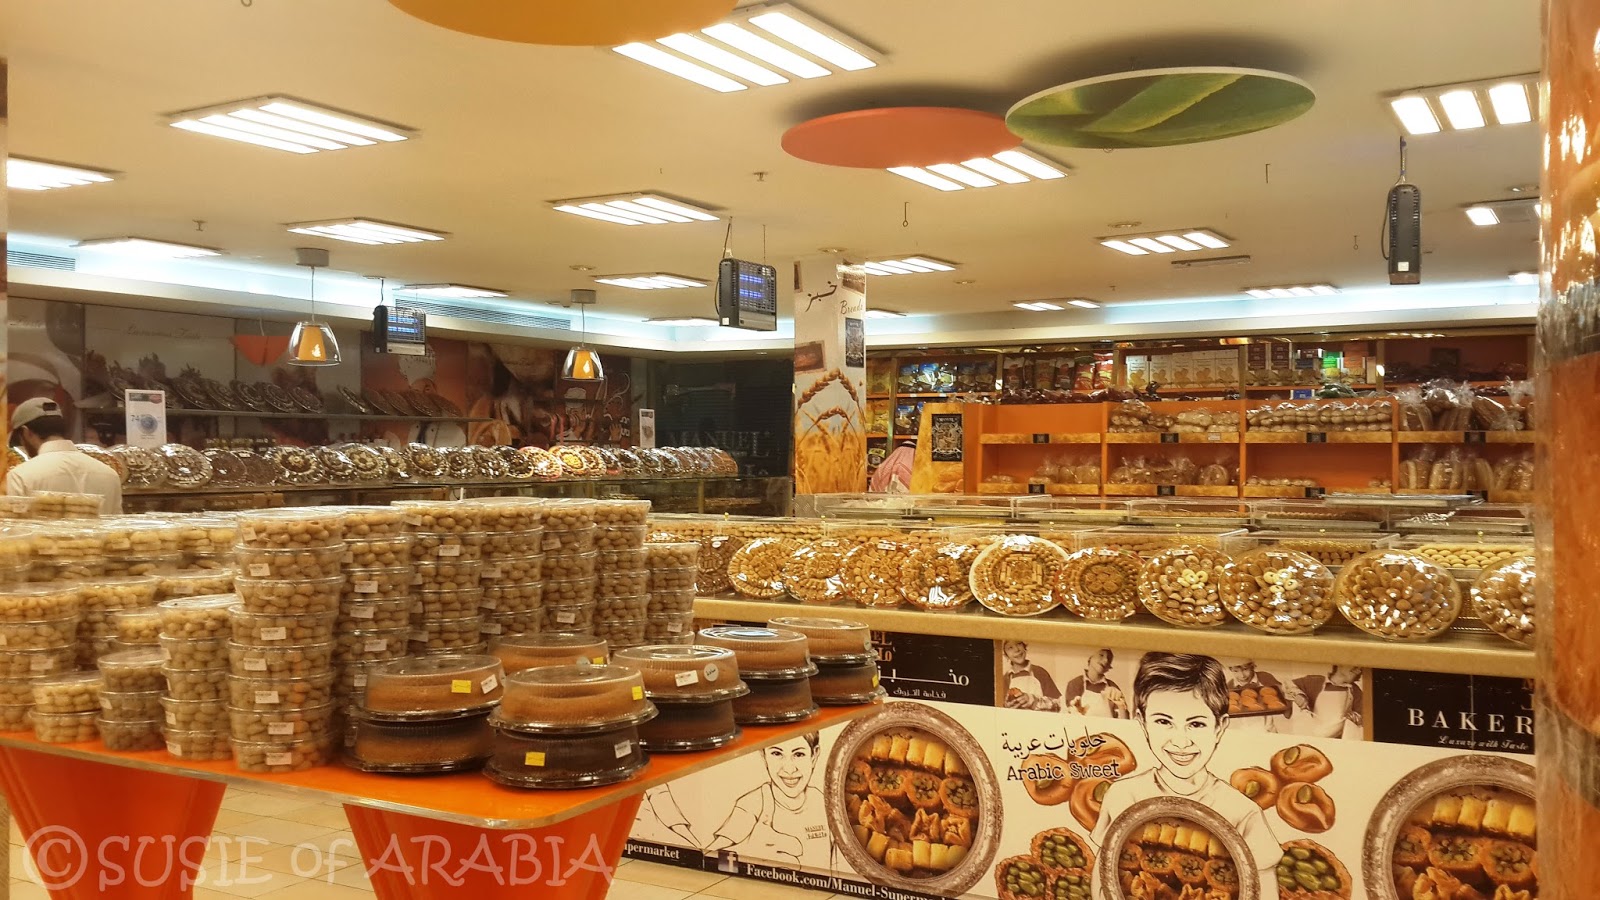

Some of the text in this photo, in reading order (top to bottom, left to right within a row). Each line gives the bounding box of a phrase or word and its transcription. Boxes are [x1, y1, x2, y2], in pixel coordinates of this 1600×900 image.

[805, 281, 837, 312] خبز
[1001, 725, 1107, 759] حلويات عربية
[1006, 758, 1121, 781] Arabic Sweet
